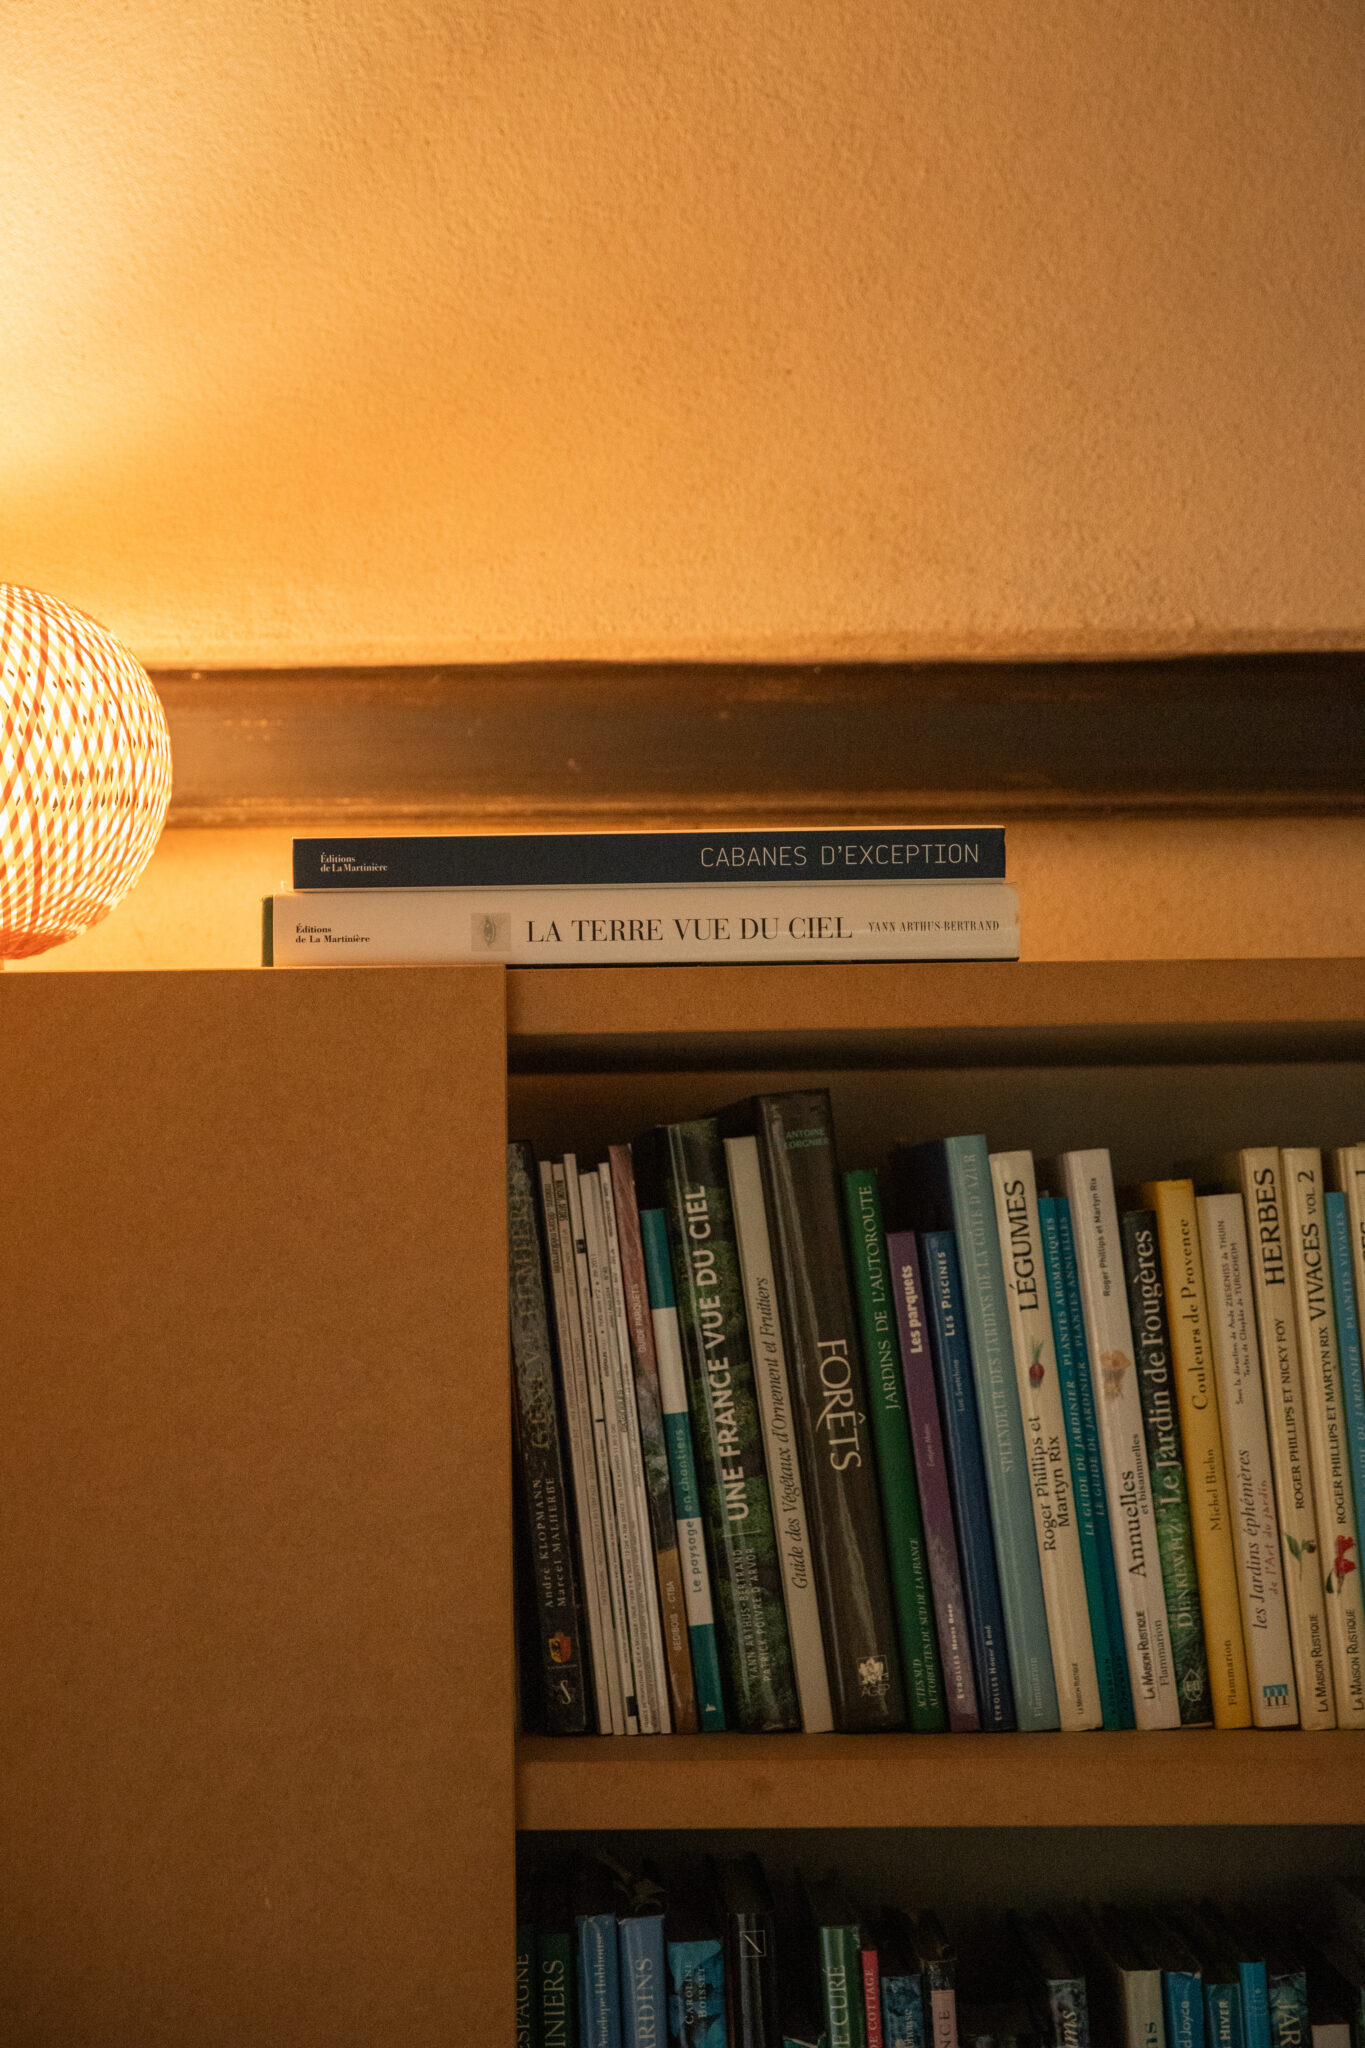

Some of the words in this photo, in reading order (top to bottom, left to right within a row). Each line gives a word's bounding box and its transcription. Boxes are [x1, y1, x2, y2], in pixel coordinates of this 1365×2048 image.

[319, 851, 356, 863] Éditions
[320, 864, 331, 873] de
[331, 863, 342, 872] La
[342, 861, 389, 872] Martinière
[700, 845, 807, 868] CABANES
[820, 843, 980, 866] D'EXCEPTION
[295, 922, 333, 936] Éditions
[295, 934, 307, 944] de
[309, 934, 322, 944] La
[323, 932, 371, 944] Martinière
[525, 920, 563, 942] LA
[571, 918, 664, 942] TERRE
[672, 917, 731, 941] VUE
[739, 917, 780, 940] DU
[788, 915, 853, 940] CIEL
[867, 920, 896, 932] YANN
[899, 919, 1000, 932] ARTHUS-BERTRAND
[785, 1129, 825, 1140] ANTOINE
[963, 1153, 981, 1204] D'AZUR
[1089, 1176, 1098, 1192] Rix
[1297, 1170, 1314, 1183] 2
[684, 1184, 711, 1240] CIEL
[968, 1209, 986, 1246] CÔTE
[1092, 1192, 1102, 1223] Martyn
[1253, 1167, 1285, 1286] HERBES
[858, 1184, 886, 1303] L'AUTOROUTE
[1003, 1179, 1040, 1312] LÉGUMES
[1096, 1224, 1104, 1234] et
[1216, 1220, 1227, 1250] THUIN
[1336, 1210, 1349, 1267] VIVACES
[693, 1248, 717, 1287] DU
[974, 1250, 990, 1267] LA
[1046, 1216, 1066, 1306] AROMATIQUES
[1059, 1216, 1078, 1288] ANNUELLES
[1098, 1235, 1108, 1269] Phillips
[1179, 1218, 1197, 1300] Provence
[1230, 1241, 1243, 1295] TURCKHEIM
[1301, 1223, 1326, 1321] VIVACES
[901, 1264, 922, 1328] parquets
[975, 1272, 991, 1290] DE
[1101, 1271, 1112, 1297] Roger
[1132, 1229, 1163, 1347] Fougères
[1220, 1262, 1234, 1308] ZIESENISS
[1342, 1270, 1355, 1330] PLANTES
[630, 1283, 643, 1327] PARQUETS
[699, 1295, 726, 1350] VUE
[756, 1277, 775, 1337] Fruitiers
[874, 1310, 889, 1332] DE
[980, 1296, 1001, 1353] JARDINS
[1065, 1290, 1084, 1347] PLANTES
[1182, 1304, 1199, 1324] de
[636, 1327, 647, 1353] GUIDE
[763, 1340, 777, 1354] et
[910, 1329, 923, 1354] Les
[1054, 1310, 1073, 1366] PLANTES
[1274, 1317, 1286, 1343] FOY
[1318, 1325, 1329, 1348] RIX
[878, 1339, 901, 1411] JARDINS
[987, 1358, 1004, 1384] DES
[1142, 1351, 1168, 1384] de
[1187, 1328, 1208, 1411] Couleurs
[1230, 1342, 1242, 1376] direction
[1241, 1354, 1252, 1378] Textes
[1278, 1344, 1290, 1384] NICKY
[1320, 1350, 1335, 1403] MARTYN
[707, 1356, 741, 1459] FRANCE
[764, 1357, 789, 1443] d'Ornement
[814, 1339, 867, 1472] FORÊTS
[956, 1398, 966, 1413] Luc
[1065, 1381, 1085, 1449] JARDINIER
[1073, 1361, 1096, 1432] JARDINIER
[1235, 1388, 1244, 1405] Sous
[1281, 1387, 1293, 1404] ET
[1326, 1405, 1337, 1421] ET
[991, 1390, 1014, 1473] SPLENDEUR
[1028, 1415, 1042, 1432] et
[1086, 1435, 1097, 1452] DU
[1147, 1389, 1182, 1469] Jardin
[1283, 1406, 1299, 1462] PHILLIPS
[674, 1428, 689, 1492] chantiers
[1031, 1436, 1050, 1498] Phillips
[1047, 1435, 1061, 1462] Rix
[1074, 1453, 1086, 1472] DU
[1131, 1433, 1147, 1502] bisannuelles
[1203, 1448, 1218, 1485] Biehn
[1327, 1422, 1343, 1478] PHILLIPS
[721, 1466, 749, 1520] UNE
[778, 1446, 801, 1513] Végétaux
[1090, 1454, 1103, 1498] GUIDE
[1158, 1475, 1181, 1506] Le
[1236, 1449, 1262, 1537] éphémères
[1291, 1464, 1305, 1510] ROGER
[545, 1477, 561, 1553] MALHERBE
[683, 1496, 693, 1512] en
[1051, 1467, 1070, 1528] Martyn
[1079, 1477, 1093, 1517] GUIDE
[1094, 1501, 1105, 1517] LE
[1140, 1504, 1149, 1515] et
[1205, 1488, 1222, 1531] Michel
[1334, 1479, 1347, 1525] ROGER
[531, 1478, 549, 1560] KLOPMANN
[784, 1518, 802, 1542] des
[1040, 1502, 1058, 1551] Roger
[1083, 1521, 1095, 1536] LE
[1119, 1469, 1147, 1578] Annuelles
[686, 1521, 701, 1574] paysage
[788, 1546, 808, 1590] Guide
[908, 1536, 922, 1576] FRANCE
[1264, 1544, 1277, 1576] l'Art
[542, 1567, 555, 1608] André
[553, 1559, 567, 1608] Marcel
[665, 1580, 676, 1603] CTBA
[913, 1576, 926, 1591] LA
[1245, 1542, 1265, 1603] Jardins
[732, 1549, 755, 1646] ARTHUS-BERTRAND
[752, 1598, 766, 1634] POIVRE
[917, 1605, 929, 1626] SUD
[1135, 1609, 1149, 1651] RUSTIQUE
[1252, 1608, 1268, 1630] les
[1308, 1613, 1322, 1659] RUSTIQUE
[1345, 1608, 1359, 1655] RUSTIQUE
[745, 1651, 759, 1680] YANN
[758, 1640, 772, 1681] PATRICK
[911, 1658, 925, 1679] SUD
[1140, 1652, 1153, 1685] MAISON
[1153, 1619, 1170, 1687] Flammarion
[1223, 1639, 1238, 1706] Flammarion
[915, 1679, 928, 1709] ACTES
[923, 1643, 940, 1708] AUTOROUTES
[952, 1654, 965, 1700] EYROLLES
[1028, 1657, 1045, 1717] Flammarion
[1314, 1660, 1327, 1698] MAISON
[1349, 1657, 1363, 1696] MAISON
[990, 1676, 1002, 1721] EYROLLES
[822, 1964, 848, 2026] CURÉ
[864, 1967, 878, 2031] COTTAGE
[1179, 2000, 1194, 2035] Joyce
[1218, 1999, 1231, 2040] HIVER
